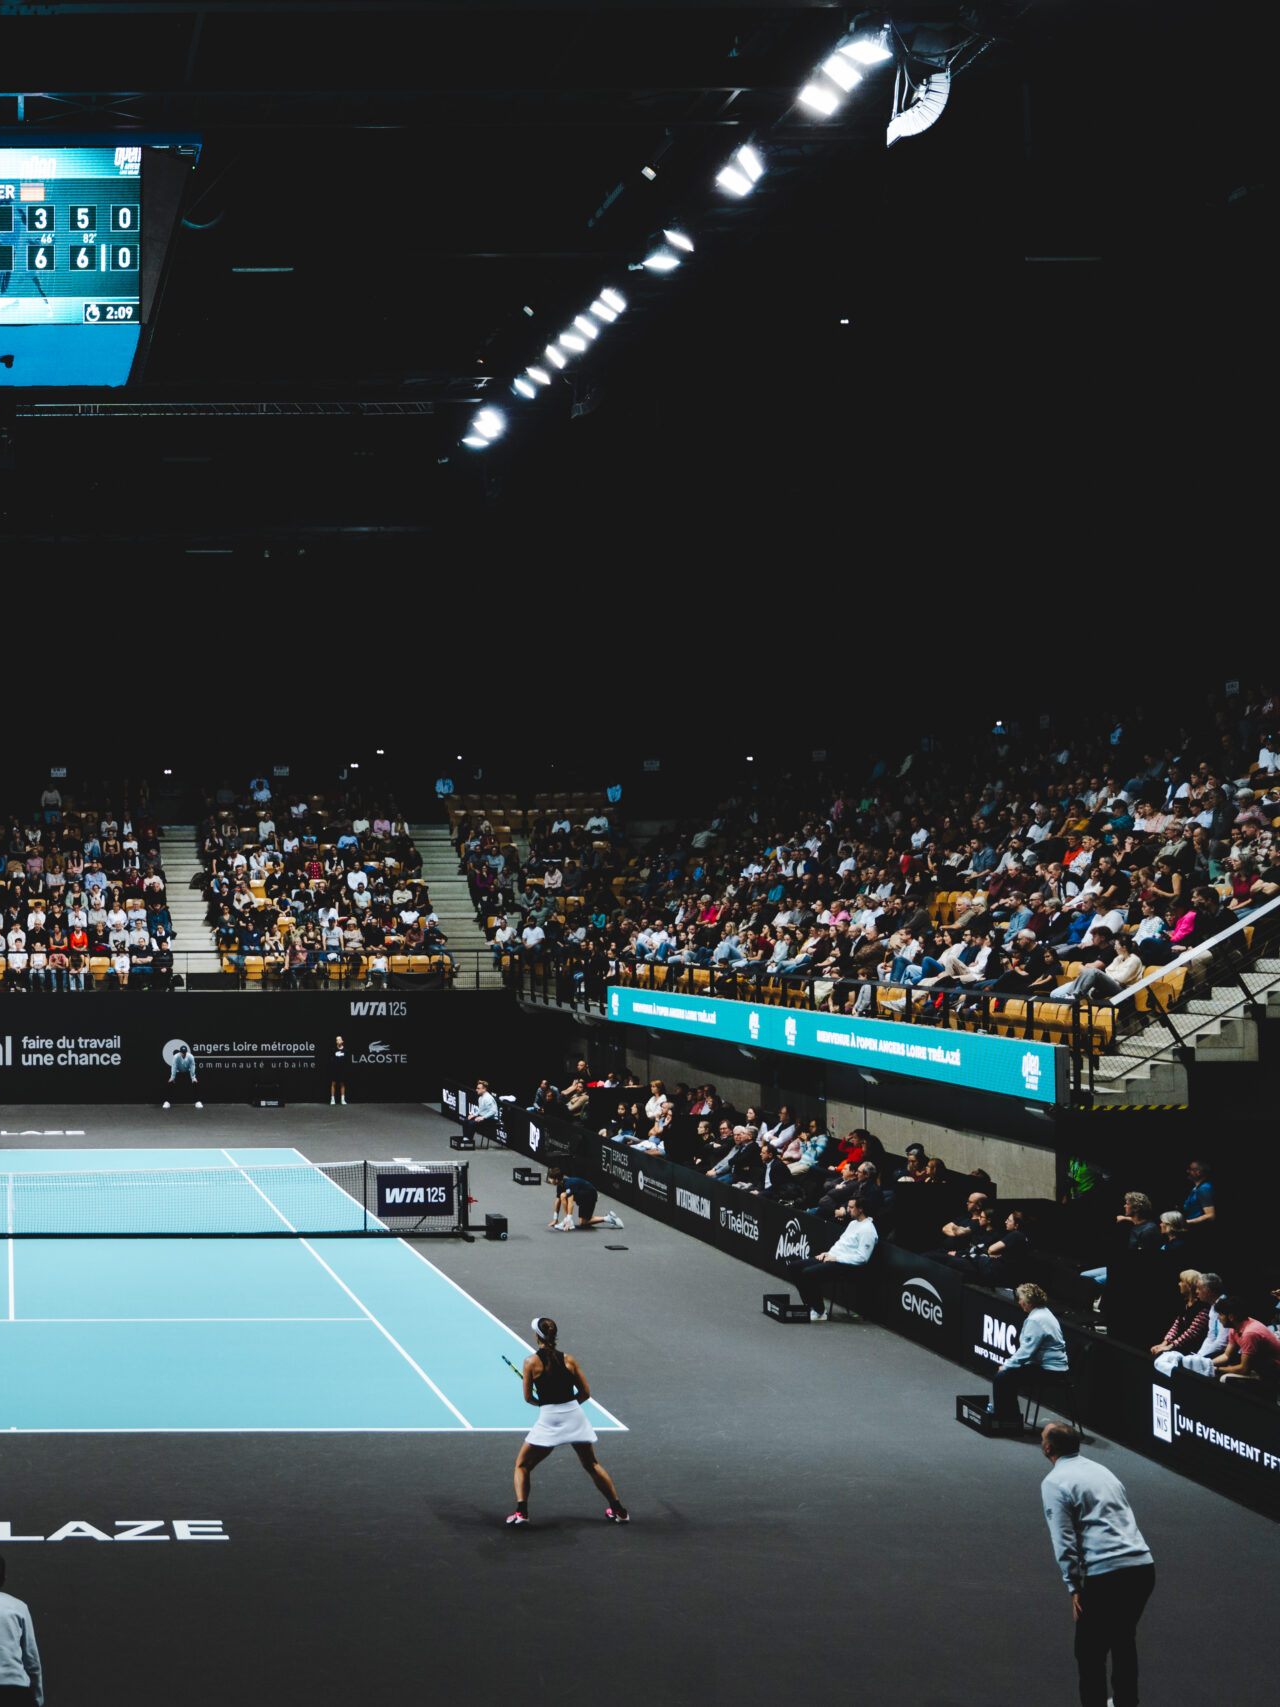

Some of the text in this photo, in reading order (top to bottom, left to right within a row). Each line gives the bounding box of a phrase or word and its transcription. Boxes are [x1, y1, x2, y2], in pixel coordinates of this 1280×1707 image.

[35, 208, 47, 229] 3
[77, 208, 89, 229] 5
[119, 207, 131, 229] 0
[35, 247, 47, 269] 6
[77, 247, 89, 269] 6
[118, 247, 131, 268] 0
[106, 306, 133, 319] 2:09
[350, 1002, 407, 1016] WTA 125
[22, 1036, 121, 1050] faire du travail
[192, 1043, 230, 1054] angers
[261, 1041, 315, 1054] métropole
[22, 1050, 122, 1066] une chance
[195, 1060, 315, 1069] ommunauté urbaine
[351, 1054, 408, 1064] LACOSTE
[385, 1187, 446, 1204] WTA 125
[775, 1233, 810, 1261] Alouette
[983, 1314, 1017, 1355] RMC
[974, 1345, 989, 1359] INFO
[1156, 1393, 1168, 1409] TEN
[1157, 1416, 1168, 1432] NIS
[1179, 1414, 1194, 1433] UN
